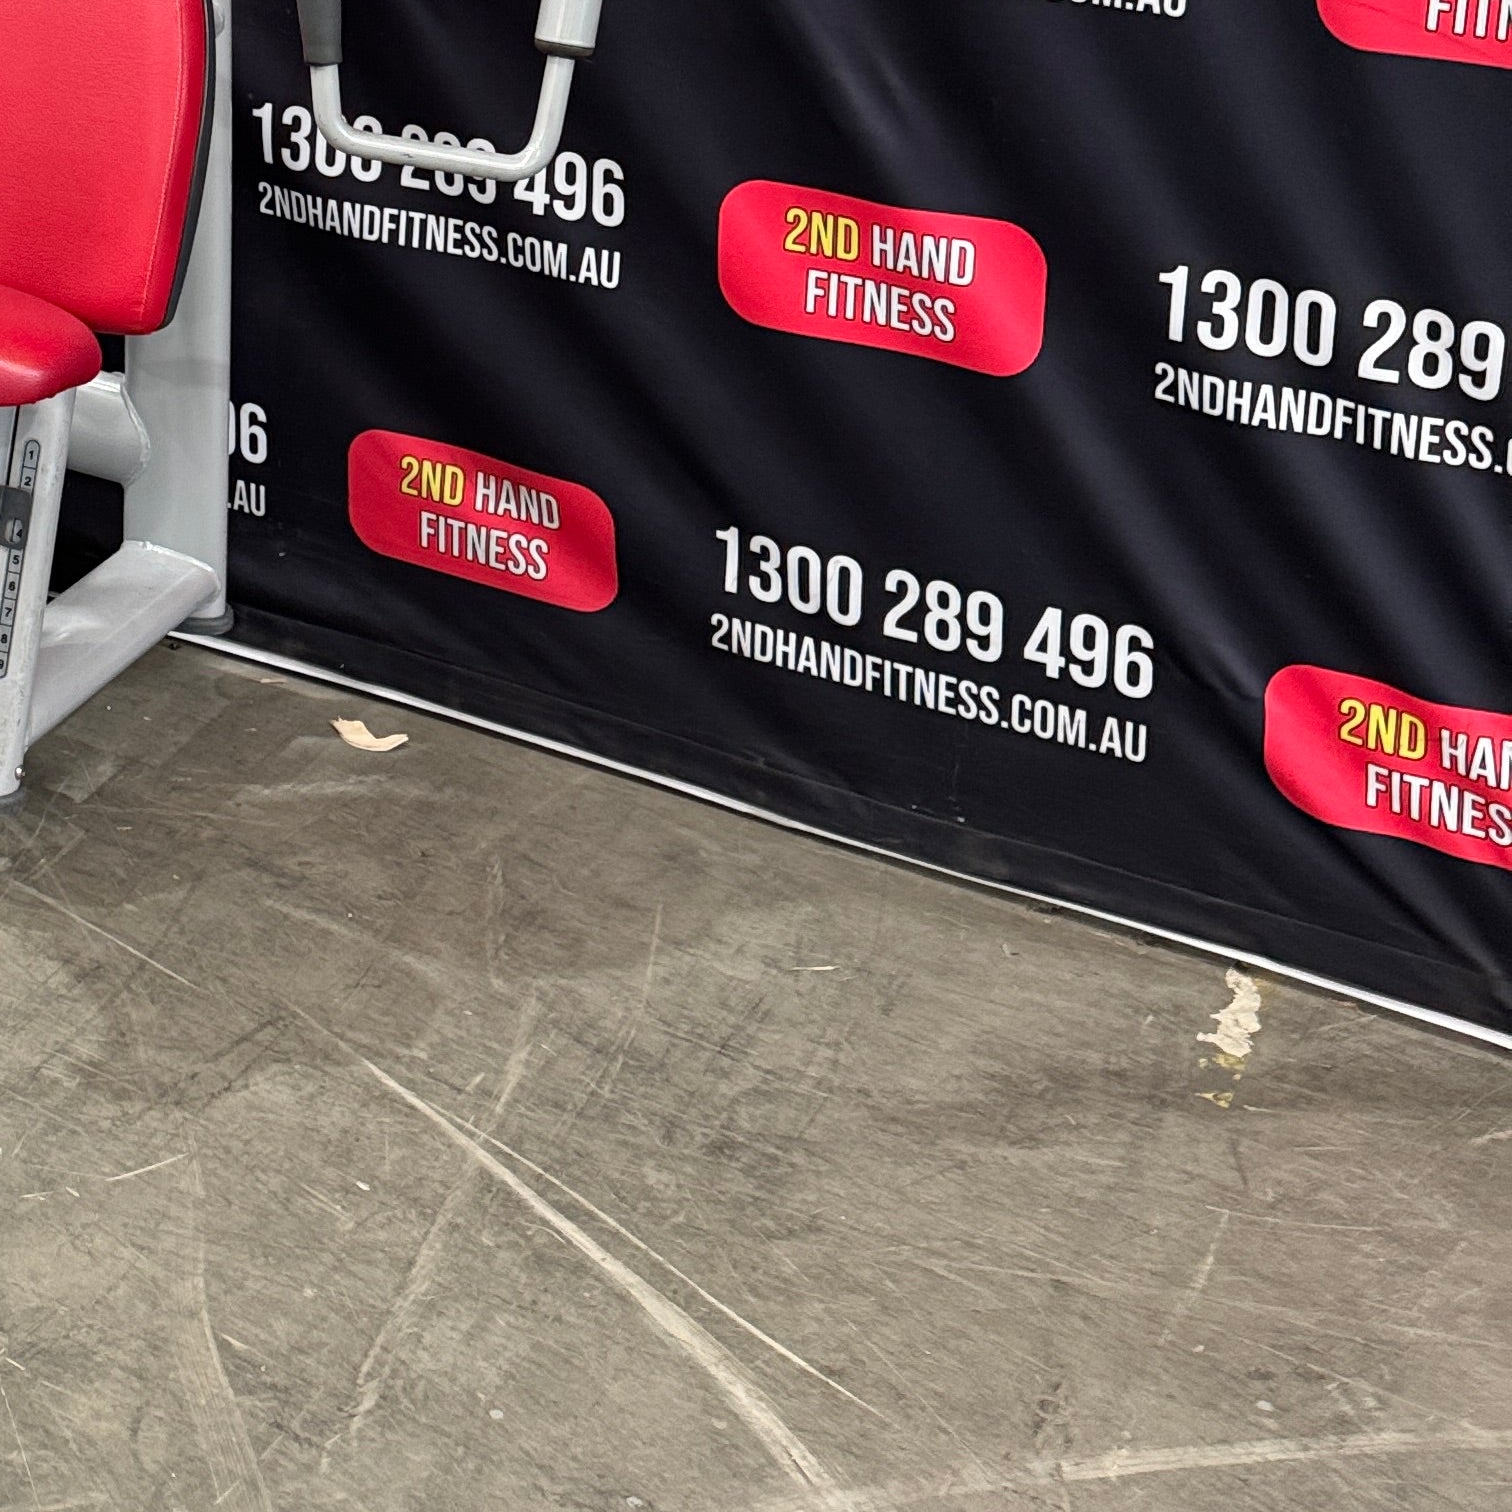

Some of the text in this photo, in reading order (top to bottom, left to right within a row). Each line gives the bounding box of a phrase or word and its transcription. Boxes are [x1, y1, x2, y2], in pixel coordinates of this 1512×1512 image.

[514, 151, 625, 228] 496
[258, 182, 620, 289] 2NDHANDFITNESS.COM.AU
[782, 207, 975, 287] 2ND HAND
[805, 269, 956, 344] FITNESS
[1159, 264, 1507, 403] 1300 289
[1154, 361, 1512, 477] 2NDHANDFITNESS.
[399, 455, 561, 531] 2ND HAND
[419, 512, 549, 582] FITNESS
[716, 525, 1155, 699] 1300 289 496
[711, 612, 1148, 763] 2NDHANDFITNESS.COM.AU
[1338, 697, 1426, 761] 2ND
